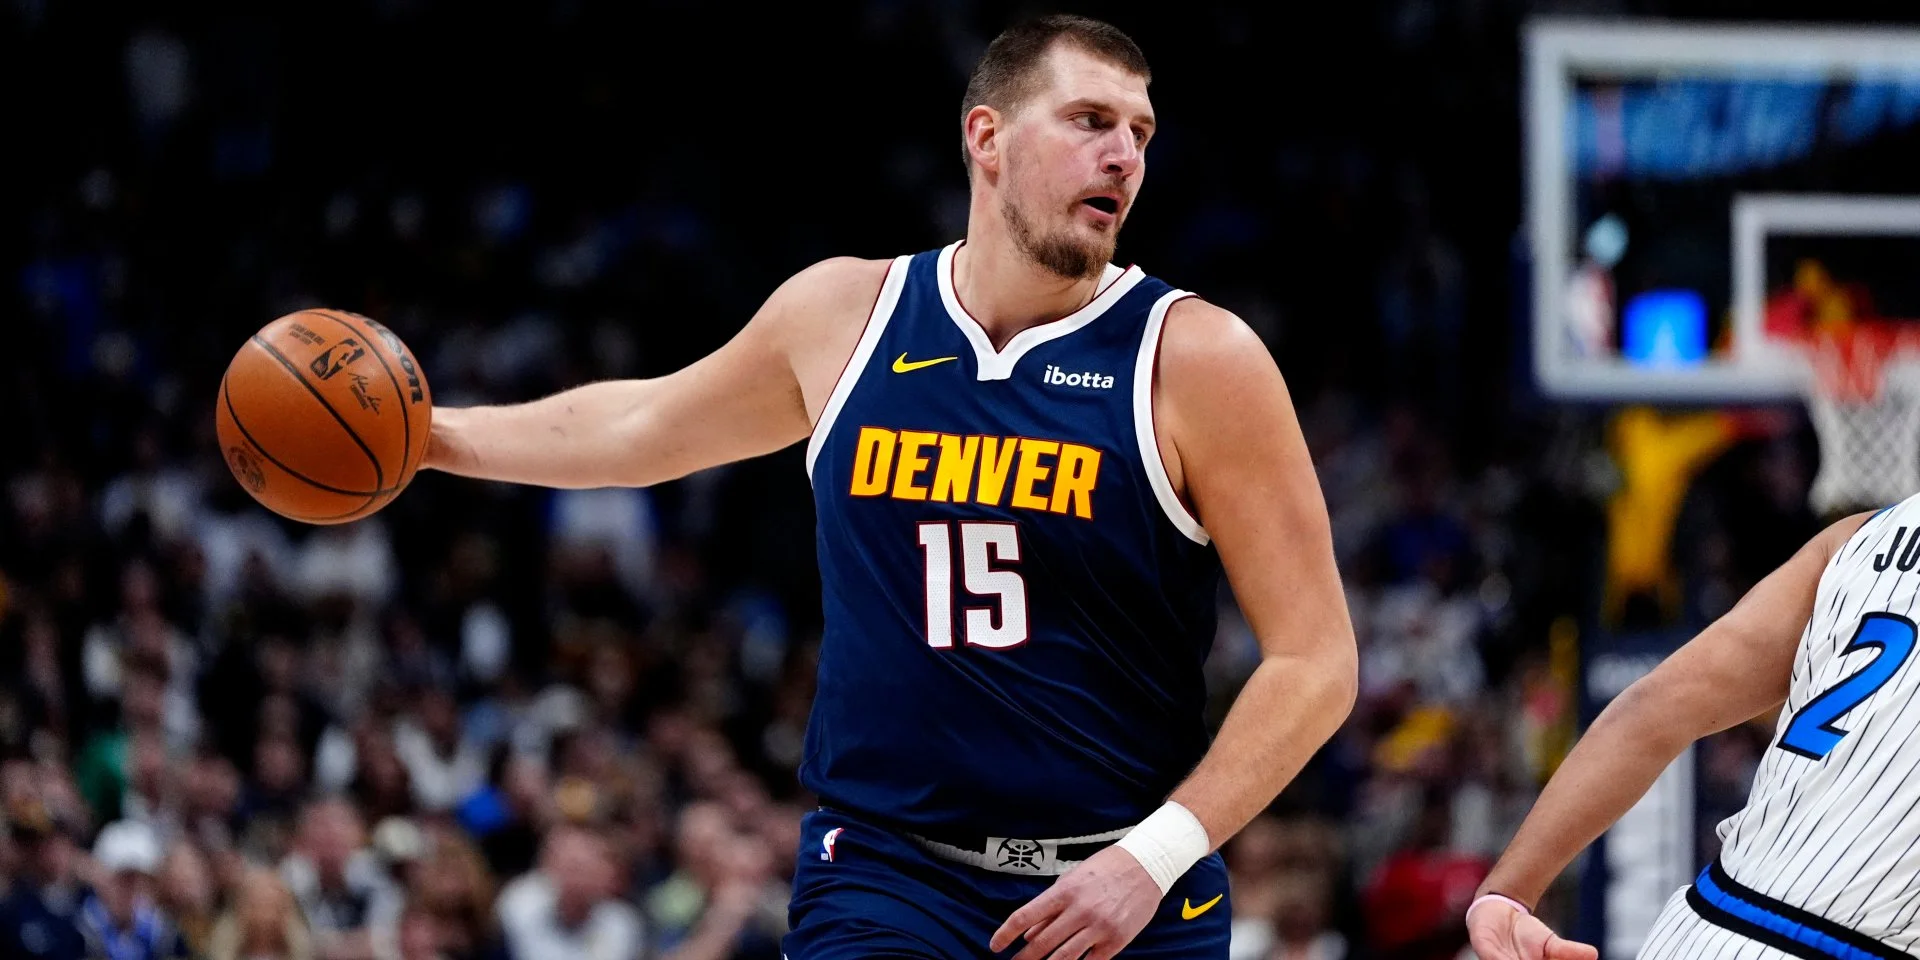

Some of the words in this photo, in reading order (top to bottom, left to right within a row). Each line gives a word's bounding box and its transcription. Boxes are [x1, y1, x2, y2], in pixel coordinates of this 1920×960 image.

[1043, 364, 1115, 389] ibotta
[850, 425, 1102, 521] DENVER
[916, 520, 1030, 650] 15
[1873, 525, 1920, 575] JO
[1776, 611, 1918, 762] 2
